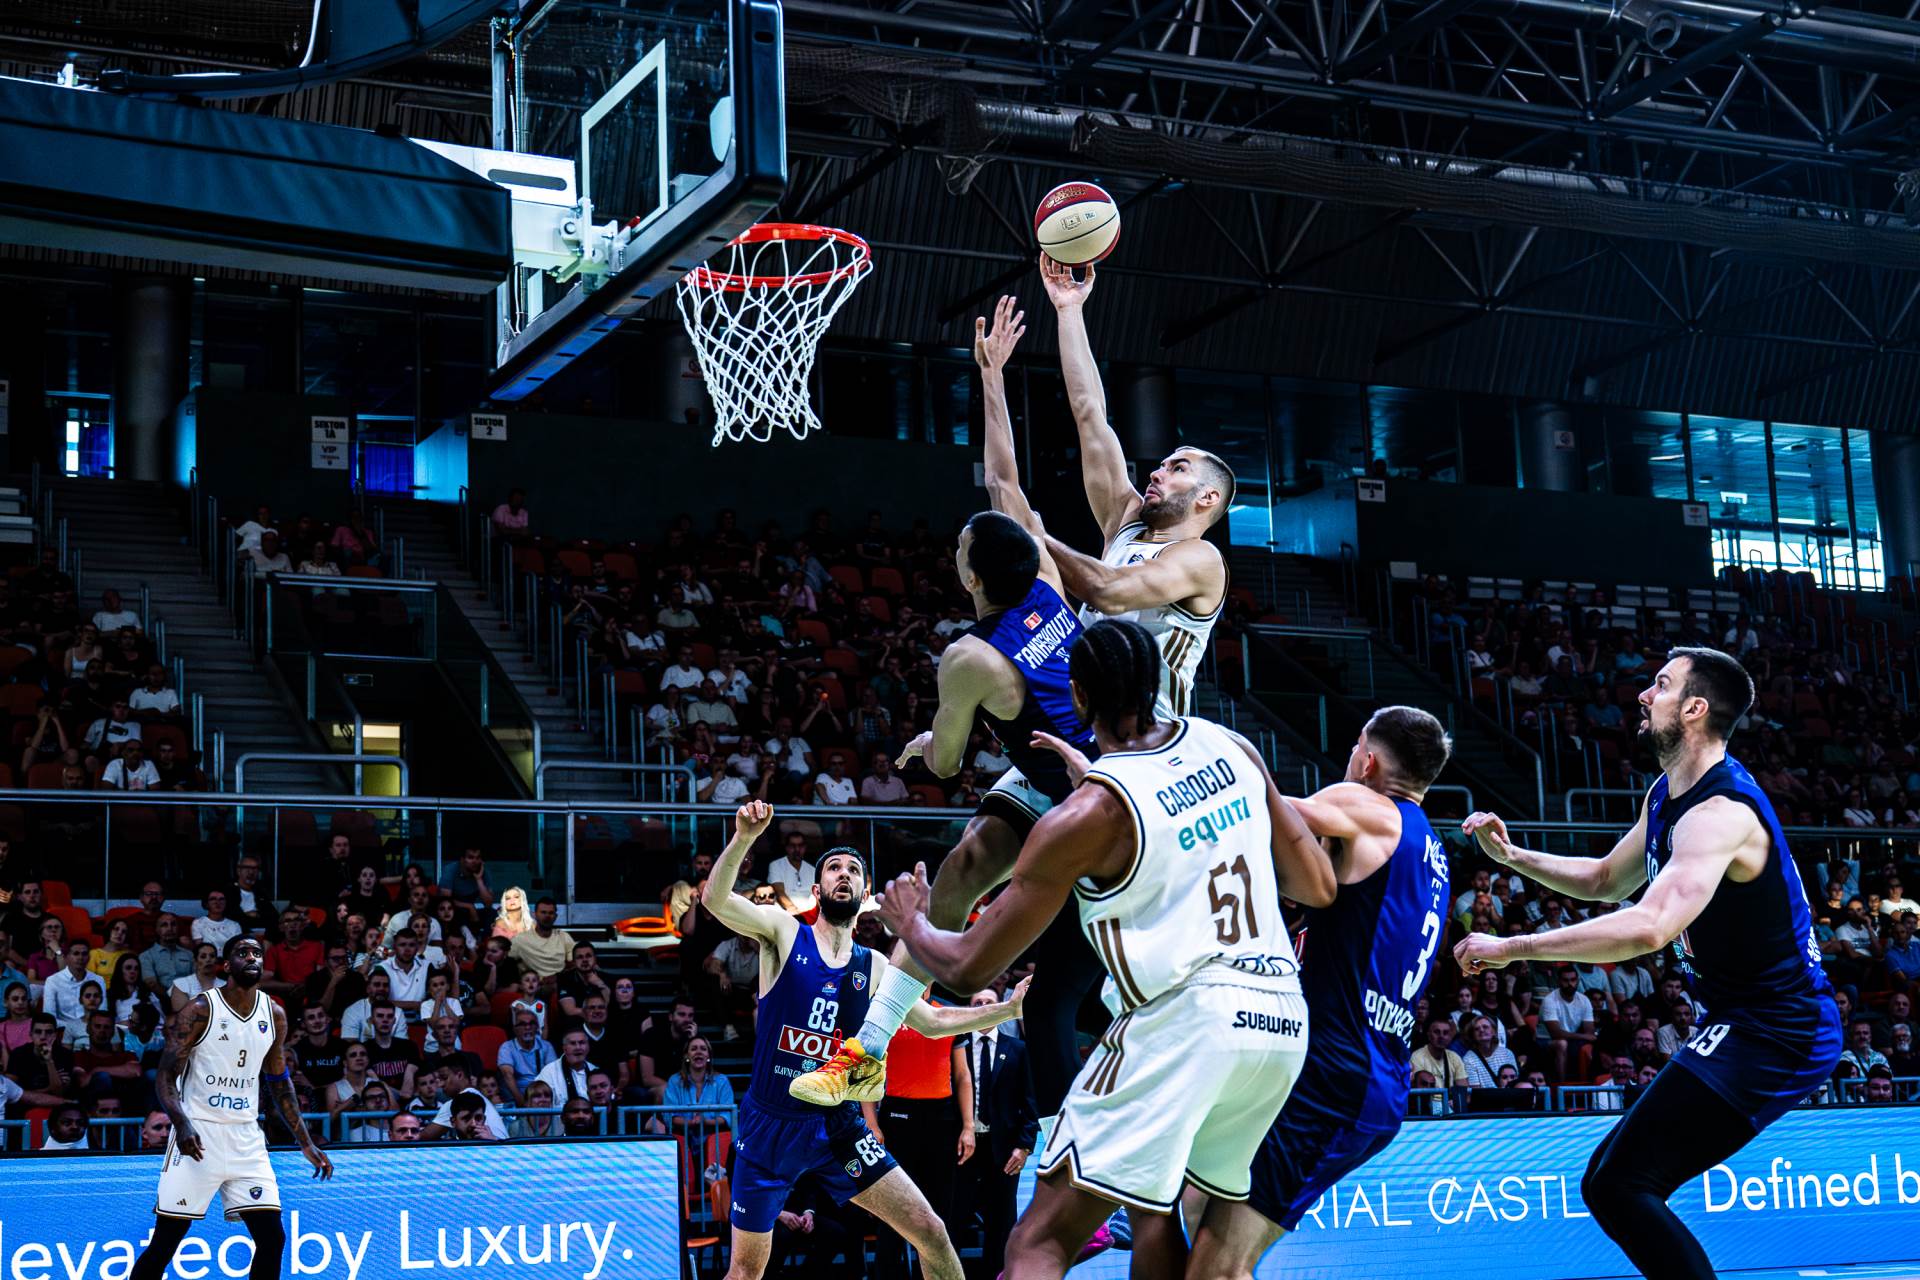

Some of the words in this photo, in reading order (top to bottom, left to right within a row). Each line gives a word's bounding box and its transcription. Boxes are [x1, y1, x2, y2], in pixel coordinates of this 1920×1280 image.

[1156, 758, 1236, 817] CABOCLO
[1208, 854, 1259, 946] 51
[1402, 910, 1440, 1001] 3
[808, 997, 839, 1033] 83
[1232, 1011, 1302, 1038] SUBWAY
[237, 1049, 247, 1068] 3
[787, 1029, 845, 1060] VOL
[1687, 1024, 1731, 1057] 19
[855, 1134, 887, 1167] 83
[1702, 1153, 1880, 1213] Defined
[291, 1210, 373, 1279] by
[400, 1209, 634, 1279] Luxury.
